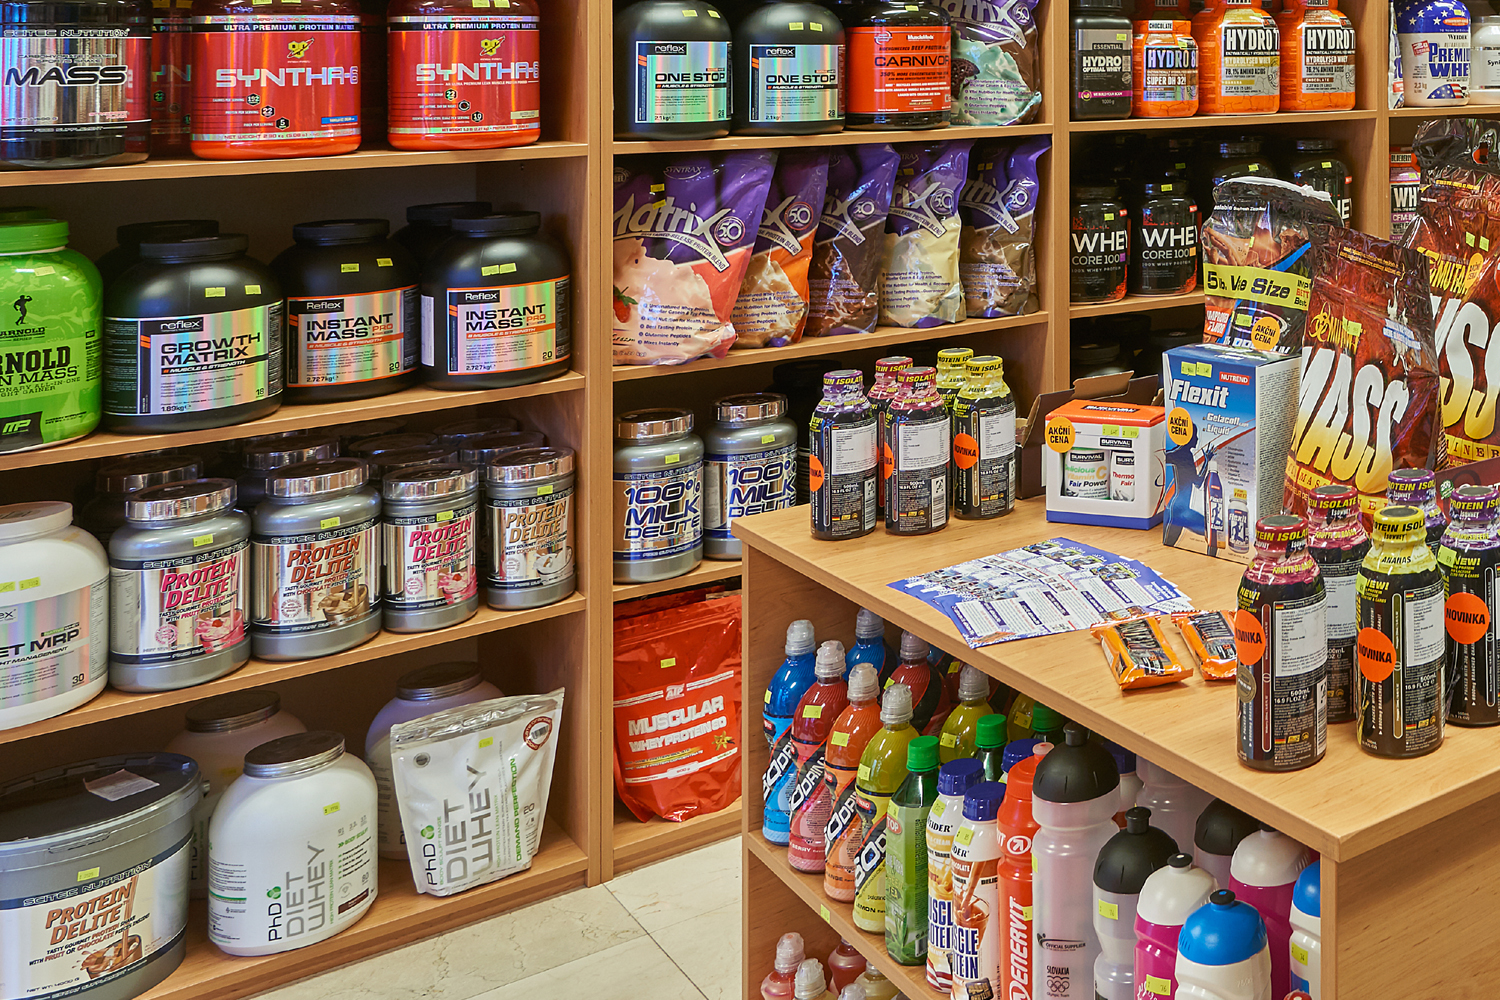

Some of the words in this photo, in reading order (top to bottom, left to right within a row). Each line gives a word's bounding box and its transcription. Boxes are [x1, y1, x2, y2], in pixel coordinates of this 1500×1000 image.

[1149, 22, 1173, 30] CHOCOLATE
[1227, 29, 1270, 50] HYDRO
[1307, 29, 1349, 50] HYDRO
[655, 45, 685, 55] reflex
[766, 47, 795, 57] reflex
[1082, 56, 1121, 68] HYDRO
[5, 65, 128, 88] MASS
[655, 72, 691, 83] ONE
[693, 72, 726, 83] STOP
[766, 75, 799, 84] ONE
[802, 75, 836, 84] STOP
[1072, 256, 1102, 265] CORE
[1104, 254, 1120, 264] 100
[1142, 250, 1172, 260] CORE
[1175, 248, 1189, 258] 100
[465, 291, 498, 302] Reflex
[1251, 278, 1290, 299] Size
[306, 301, 342, 312] Reflex
[465, 304, 547, 322] INSTANT
[160, 319, 202, 332] reflex
[306, 313, 394, 333] INSTANT
[465, 317, 524, 333] MASS
[306, 327, 369, 342] MASS
[1255, 327, 1276, 337] AKČNÍ
[1255, 335, 1271, 345] CENA
[160, 332, 260, 355] GROWTH
[160, 345, 249, 367] MATRIX
[1220, 373, 1248, 384] NUTREND
[1170, 379, 1229, 409] Flexit
[1170, 417, 1190, 428] AKČNÍ
[1048, 426, 1071, 437] AKČNÍ
[1050, 435, 1069, 445] CENA
[1171, 426, 1188, 437] CENA
[1101, 438, 1131, 447] SURVIVAL
[1071, 453, 1104, 461] SURVIVAL
[1113, 471, 1134, 480] Thermo
[729, 478, 796, 504] MILK
[505, 501, 568, 530] PROTEIN
[626, 497, 700, 528] MILK
[408, 517, 473, 546] PROTEIN
[508, 520, 563, 545] DELITE
[286, 537, 361, 568] PROTEIN
[412, 538, 470, 564] DELITE
[1382, 556, 1412, 564] ANANAS
[160, 556, 238, 593] PROTEIN
[290, 560, 355, 585] DELITE
[166, 579, 231, 611] DELITE
[628, 695, 725, 736] MUSCULAR
[442, 798, 469, 887] DIET
[45, 883, 133, 932] PROTEIN
[285, 870, 306, 939] DIET
[49, 908, 123, 946] DELITE
[267, 904, 284, 943] PhD
[1046, 966, 1070, 976] SLOVAKIA
